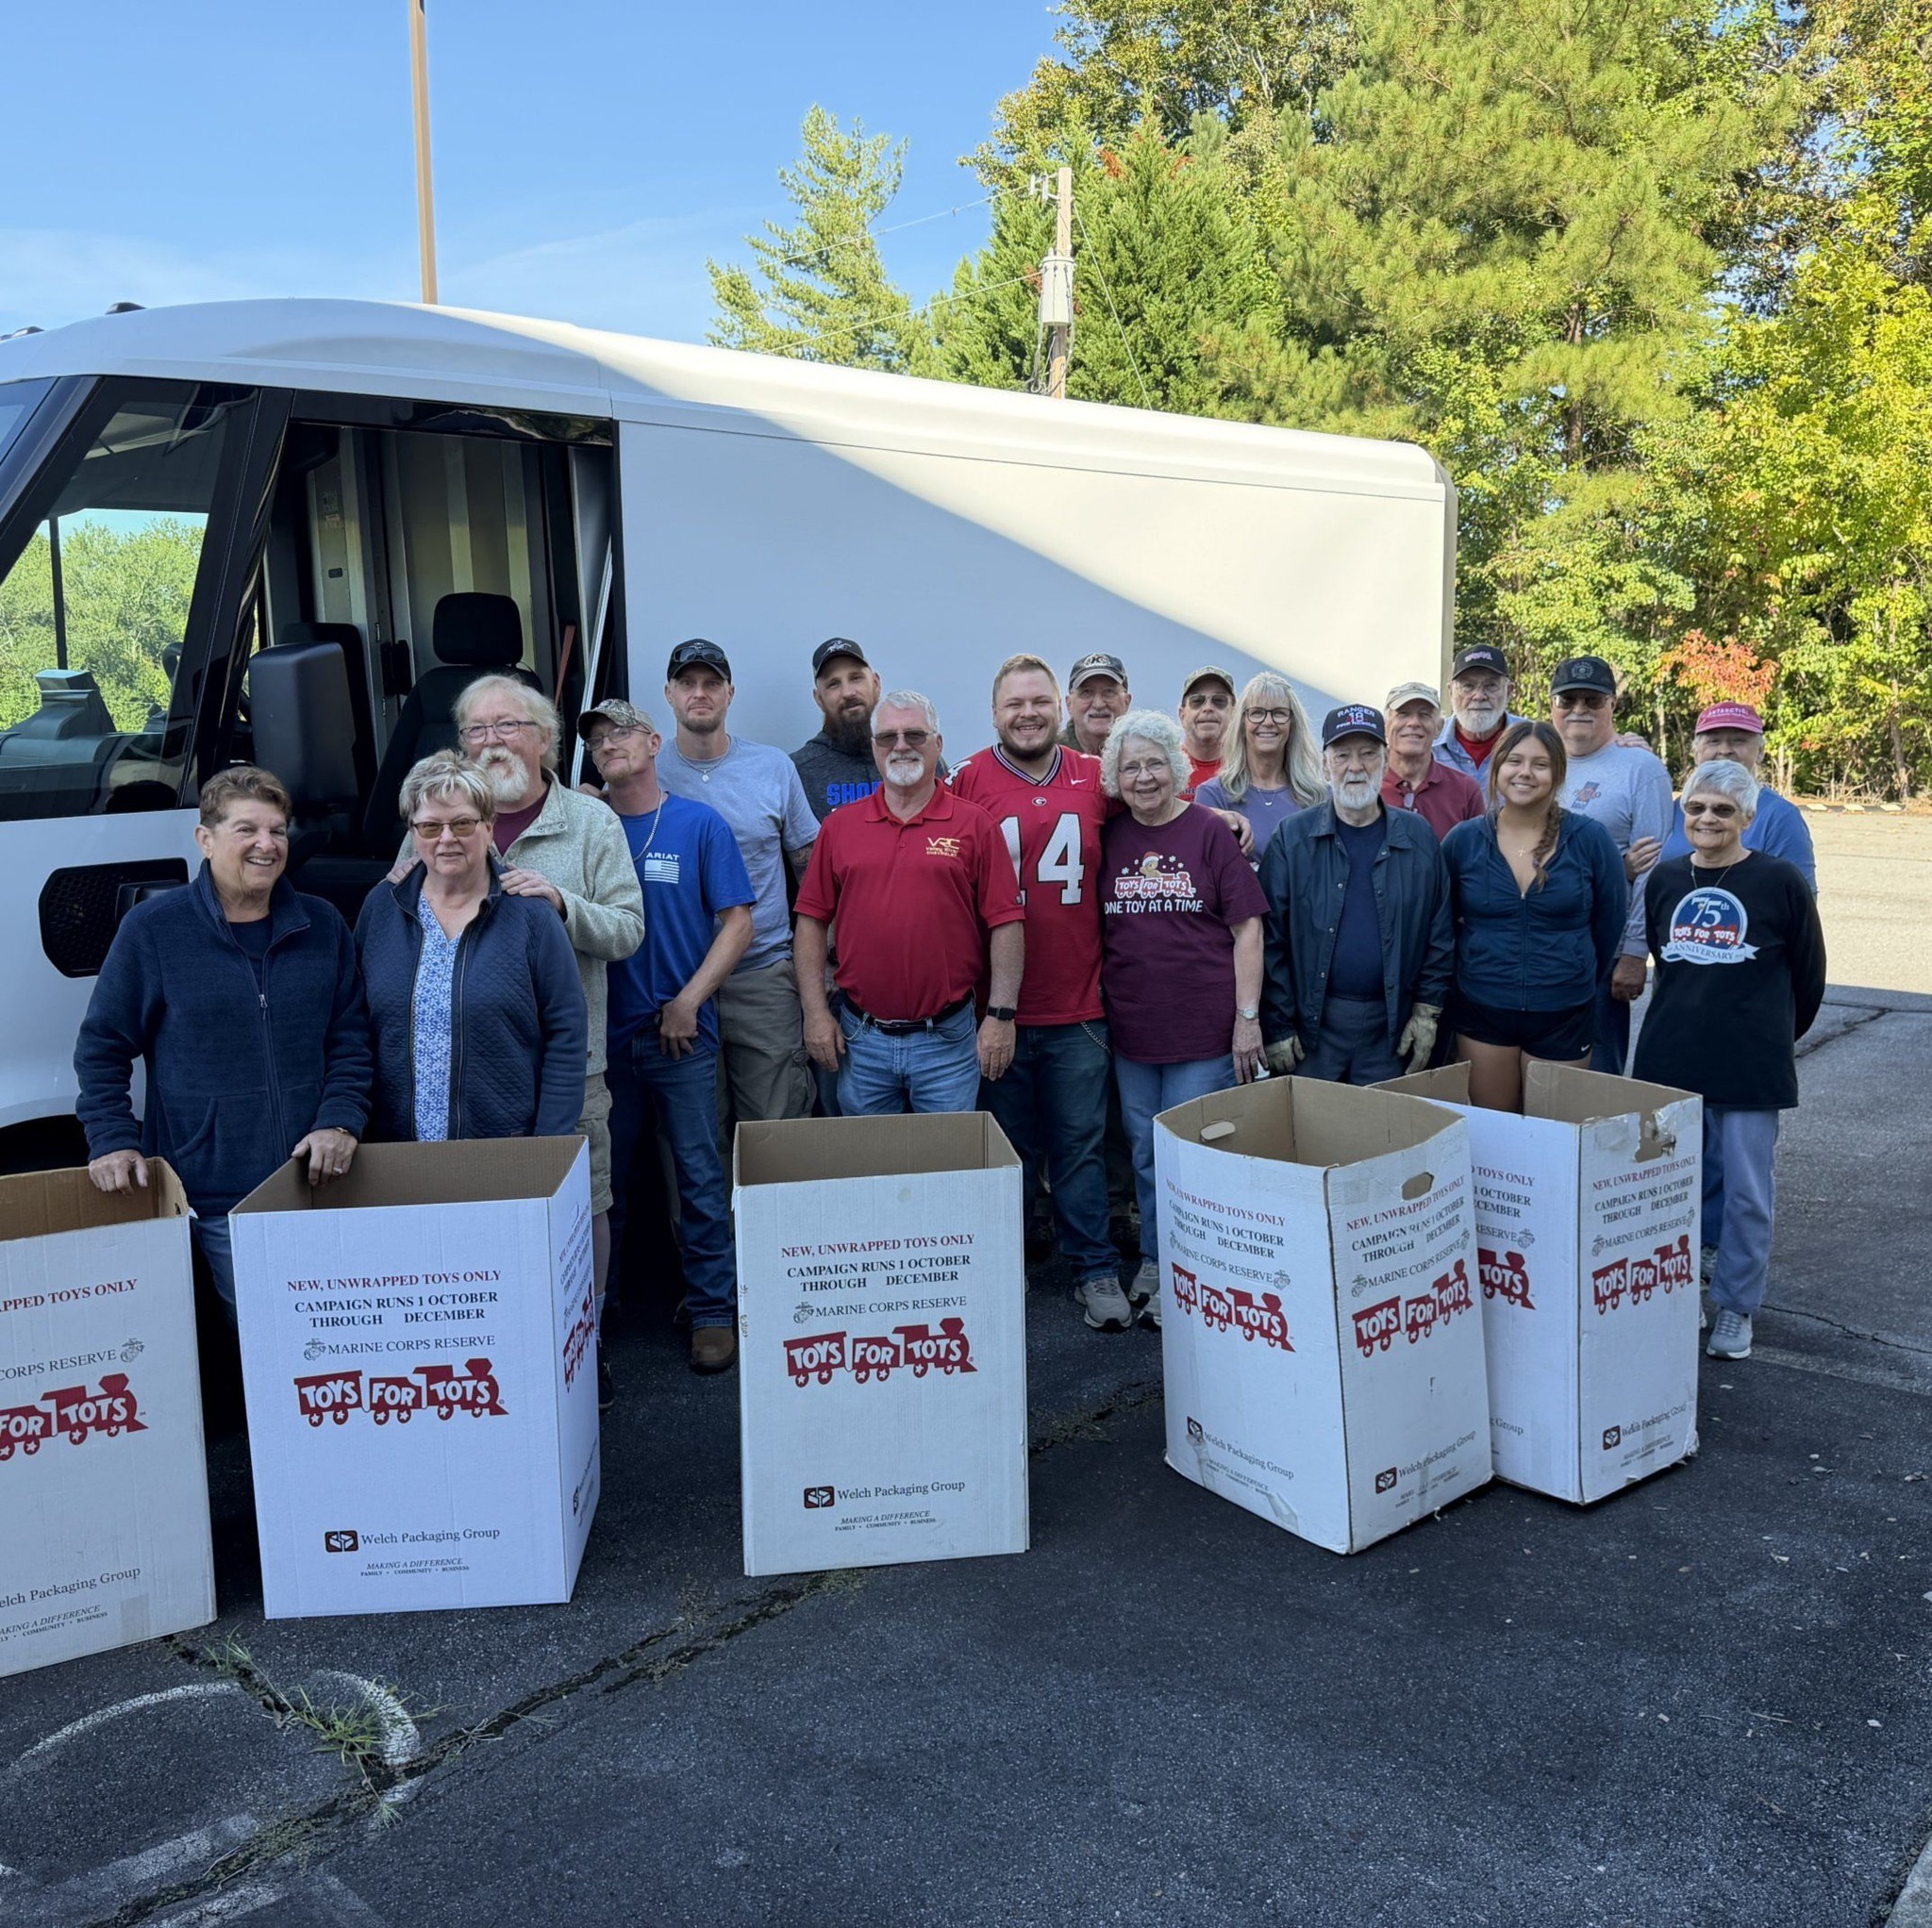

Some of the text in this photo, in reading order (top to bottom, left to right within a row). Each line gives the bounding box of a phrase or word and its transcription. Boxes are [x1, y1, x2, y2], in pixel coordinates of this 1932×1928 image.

[1337, 706, 1375, 718] RANGER
[1348, 712, 1364, 723] 18
[646, 852, 679, 861] ARIAT
[1119, 880, 1188, 890] TOYS FOR TOTS
[1105, 899, 1203, 914] ONE TOY AT A TIME
[1674, 926, 1736, 941] TOYS FOR TOTS
[1674, 944, 1734, 960] ANNIVERSARY
[1477, 1166, 1505, 1180] TOYS
[1506, 1172, 1535, 1187] ONLY
[1613, 1166, 1662, 1188] UNWRAPPED
[1662, 1160, 1680, 1174] TOYS
[1480, 1187, 1531, 1206] OCTOBER
[1594, 1175, 1694, 1212] CAMPAIGN RUNS 1 OCTOBER
[1225, 1206, 1254, 1221] TOYS
[1256, 1212, 1286, 1226] ONLY
[1374, 1197, 1432, 1223] UNWRAPPED
[1602, 1191, 1689, 1224] THROUGH DECEMBER
[1201, 1217, 1224, 1233] RUNS
[1225, 1225, 1230, 1235] 1
[1232, 1227, 1285, 1246] OCTOBER
[1352, 1226, 1407, 1251] CAMPAIGN
[1435, 1196, 1464, 1222] OCTOBER
[1605, 1215, 1688, 1248] MARINE CORPS RESERVE
[781, 1234, 975, 1257] NEW, UNWRAPPED TOYS ONLY
[1174, 1216, 1275, 1259] THROUGH DECEMBER
[1362, 1214, 1460, 1263] THROUGH DECEMBER
[788, 1255, 971, 1278] CAMPAIGN RUNS 1 OCTOBER
[1201, 1254, 1227, 1271] CORPS
[1229, 1265, 1274, 1284] RESERVE
[1369, 1238, 1461, 1288] MARINE CORPS RESERVE
[288, 1270, 501, 1292] NEW, UNWRAPPED TOYS ONLY
[800, 1271, 959, 1292] THROUGH DECEMBER
[1479, 1264, 1523, 1295] TOTS
[1595, 1255, 1689, 1297] TOYS FOR TOTS
[0, 1279, 137, 1312] PPED TOYS ONLY
[294, 1291, 498, 1313] CAMPAIGN RUNS 1 OCTOBER
[816, 1296, 967, 1318] MARINE CORPS RESERVE
[1174, 1272, 1282, 1338] TOYS FOR TOTS
[309, 1308, 485, 1328] THROUGH DECEMBER
[1357, 1280, 1465, 1339] TOYS FOR TOTS
[328, 1336, 495, 1355] MARINE CORPS RESERVE
[790, 1338, 962, 1369] TOYS FOR TOTS
[49, 1349, 117, 1371] RESERVE
[301, 1378, 491, 1408] TOYS FOR TOTS
[0, 1397, 127, 1438] FOR TOTS
[1495, 1417, 1524, 1436] Group
[1457, 1431, 1476, 1448] Group
[1226, 1443, 1266, 1470] Packaging
[1267, 1461, 1294, 1480] Group
[838, 1481, 965, 1500] Welch Packaging Group
[841, 1515, 873, 1524] MAKING
[880, 1510, 930, 1521] DIFFERENCE
[361, 1527, 500, 1545] Welch Packaging Group
[367, 1561, 401, 1570] MAKING
[409, 1557, 463, 1568] DIFFERENCE
[0, 1568, 141, 1607] elch Packaging Group
[0, 1604, 101, 1636] AKING A DIFFERENCE
[23, 1612, 108, 1637] COMMUNITY BUSINESS
